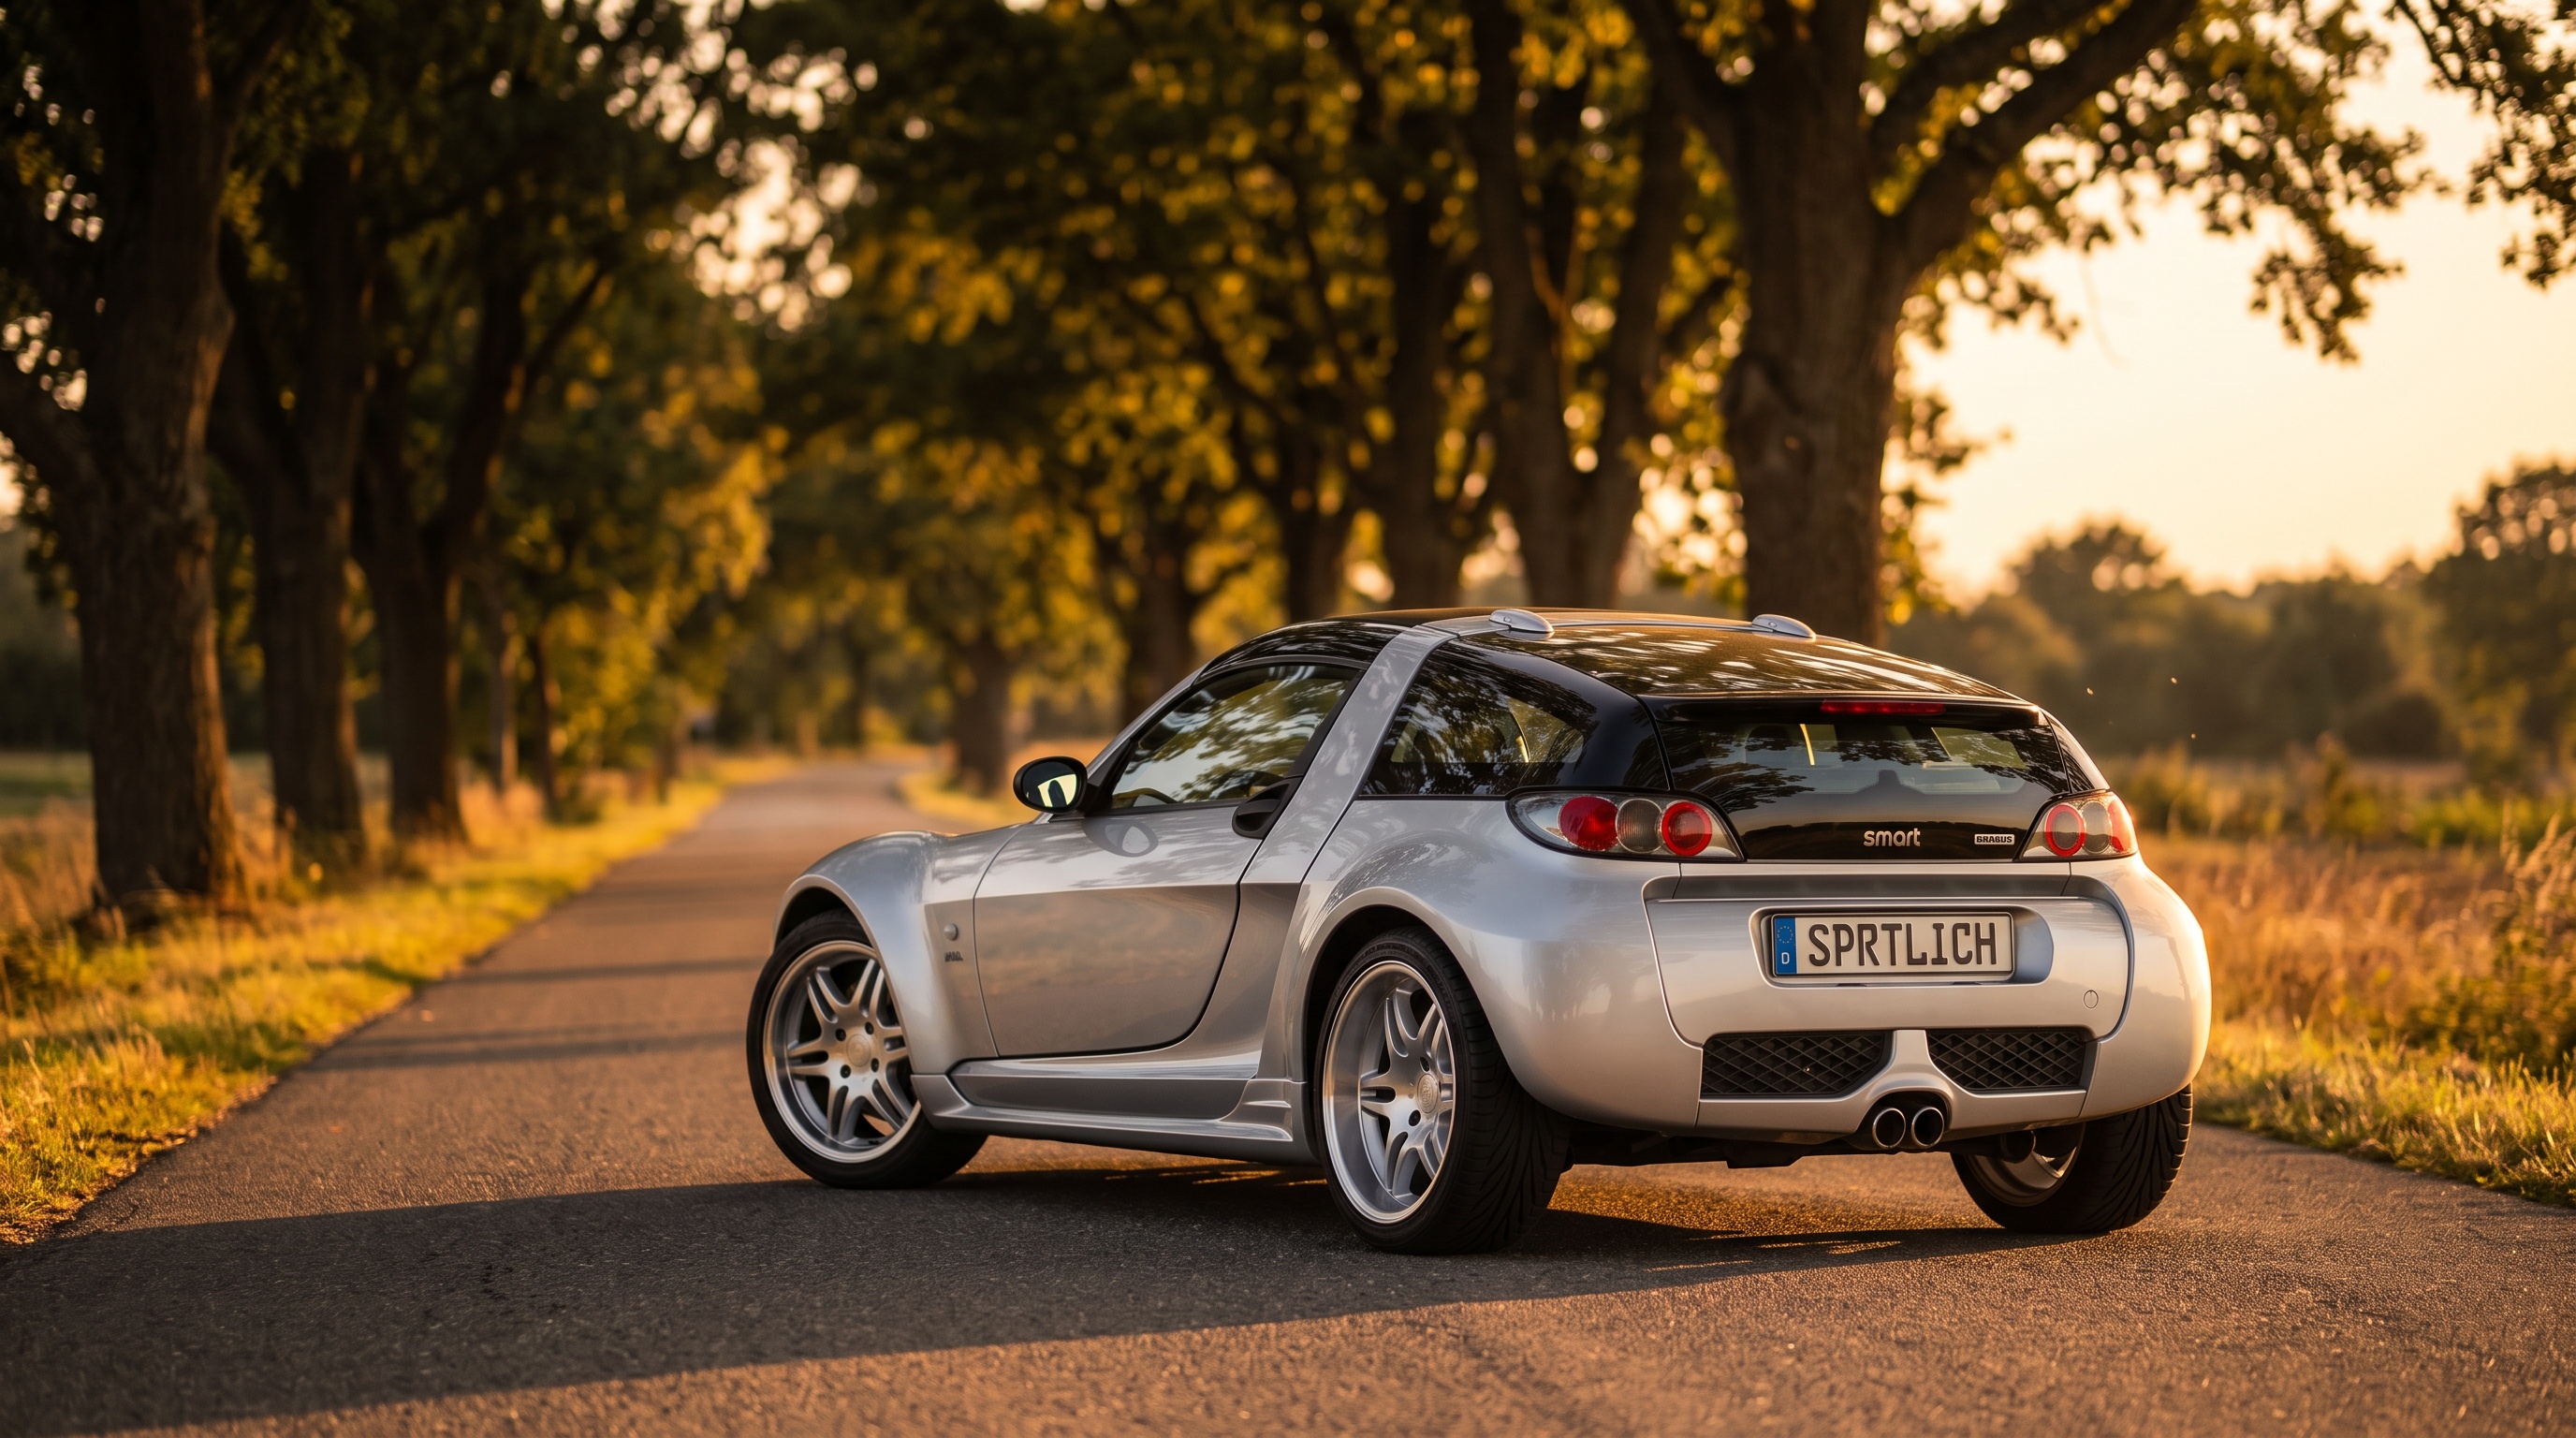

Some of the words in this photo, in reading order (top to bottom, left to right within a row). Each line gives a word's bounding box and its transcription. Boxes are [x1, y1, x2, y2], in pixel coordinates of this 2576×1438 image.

[1863, 828, 1921, 847] smart
[1976, 835, 2012, 844] BRABUS
[1808, 922, 1997, 966] SPRTLICH
[1781, 951, 1790, 964] D
